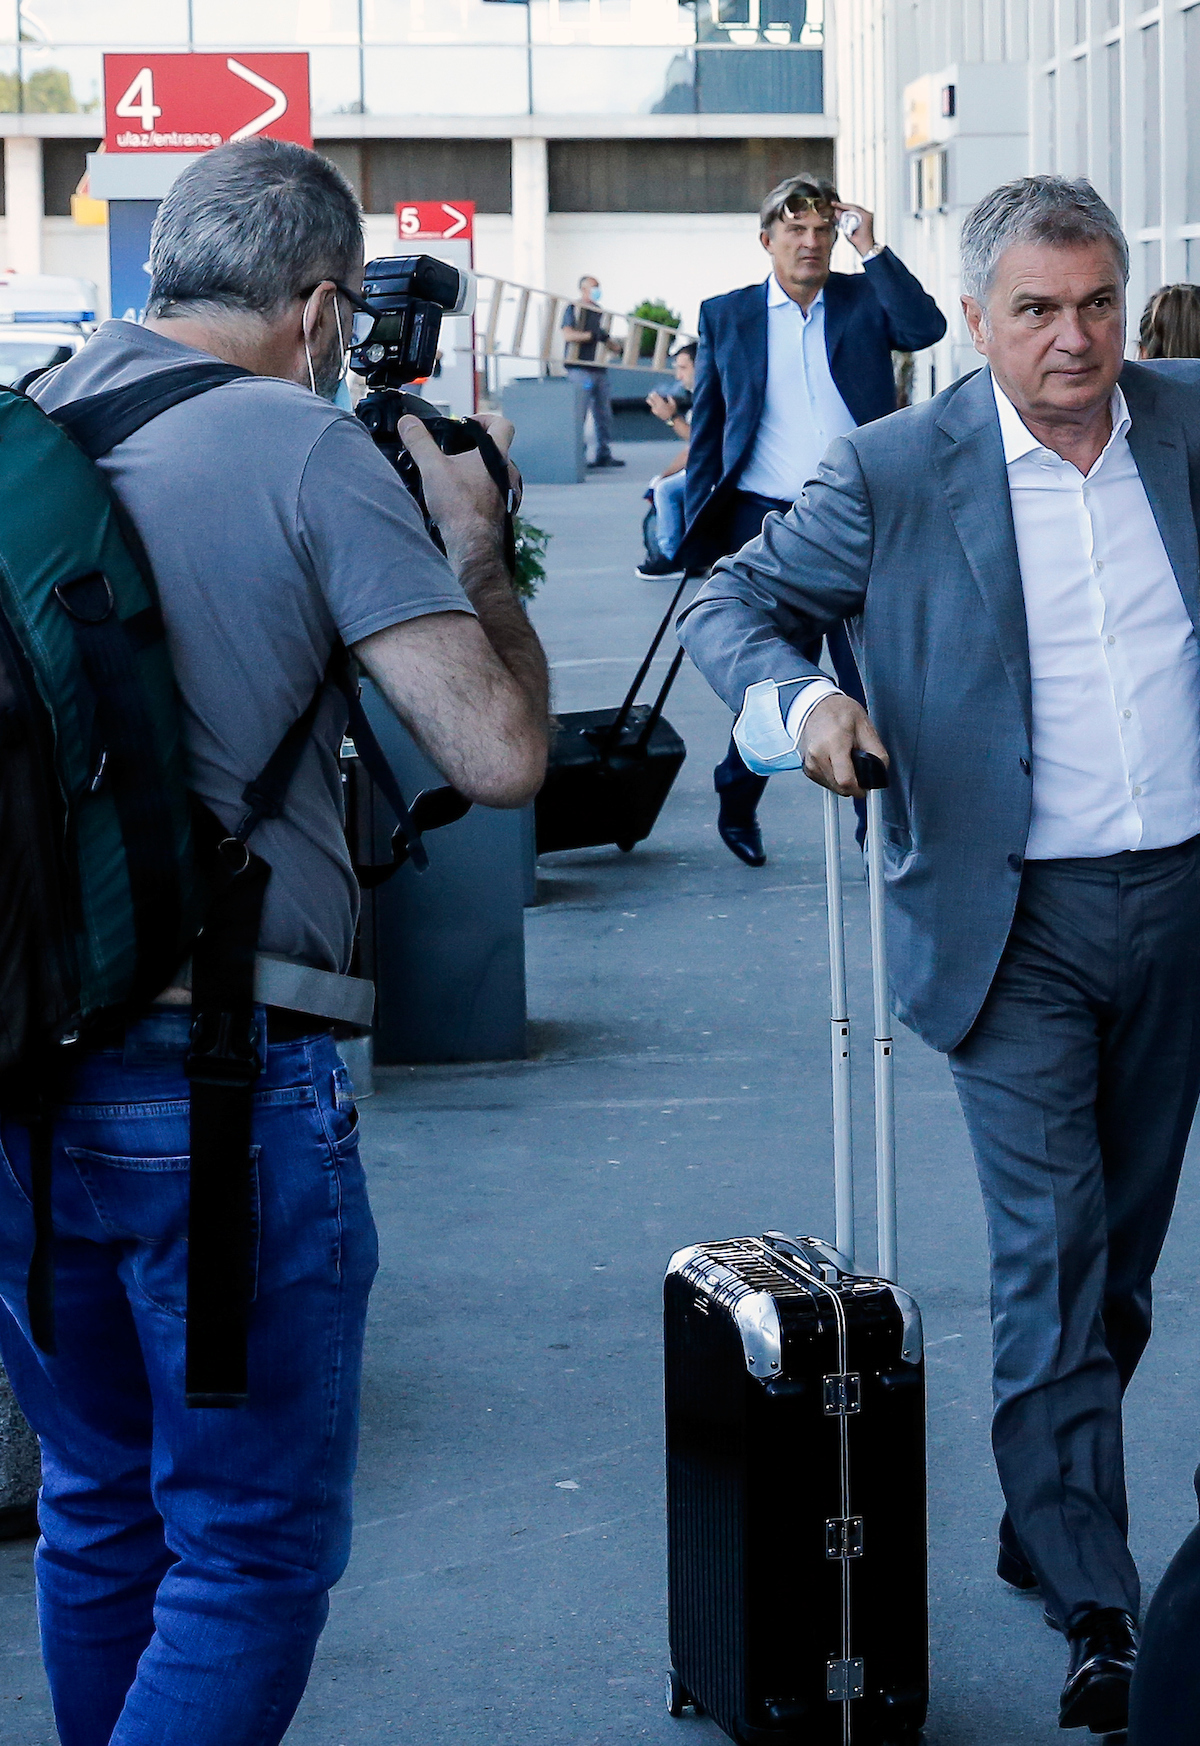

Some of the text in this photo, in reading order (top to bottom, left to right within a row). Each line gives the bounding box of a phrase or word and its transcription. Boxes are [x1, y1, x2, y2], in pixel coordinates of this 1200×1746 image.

[115, 66, 163, 132] 4
[115, 130, 223, 147] ulaz/entrance
[400, 206, 421, 235] 5
